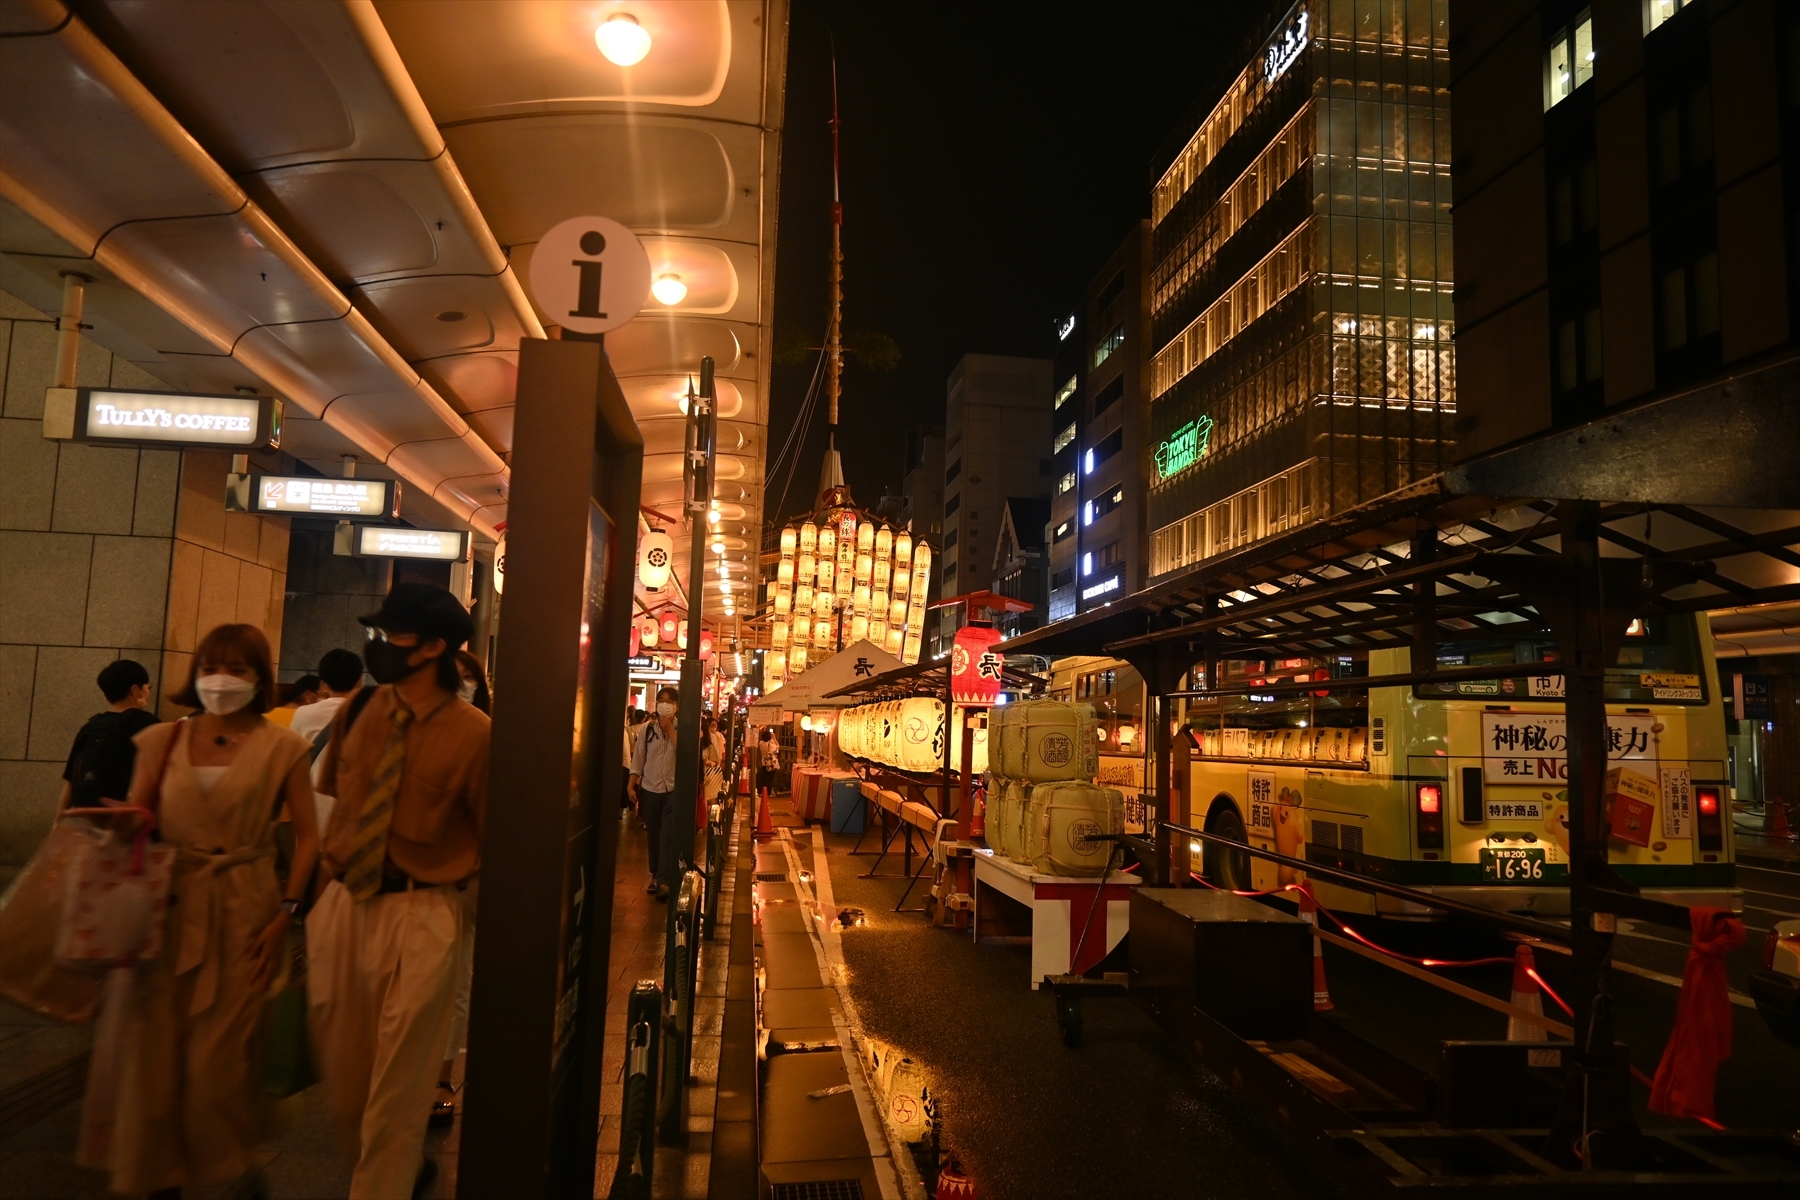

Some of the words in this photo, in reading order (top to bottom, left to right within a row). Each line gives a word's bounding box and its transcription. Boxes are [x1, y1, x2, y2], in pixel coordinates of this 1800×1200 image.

[174, 414, 250, 431] COFFEE
[1169, 428, 1195, 459] TOKYU
[1167, 446, 1194, 476] HANDS
[854, 657, 875, 678] 長
[979, 654, 1002, 681] 長
[1252, 778, 1271, 802] 特許
[1252, 804, 1271, 828] 商品
[1489, 804, 1539, 817] 特許商品
[1496, 859, 1542, 879] 16-96
